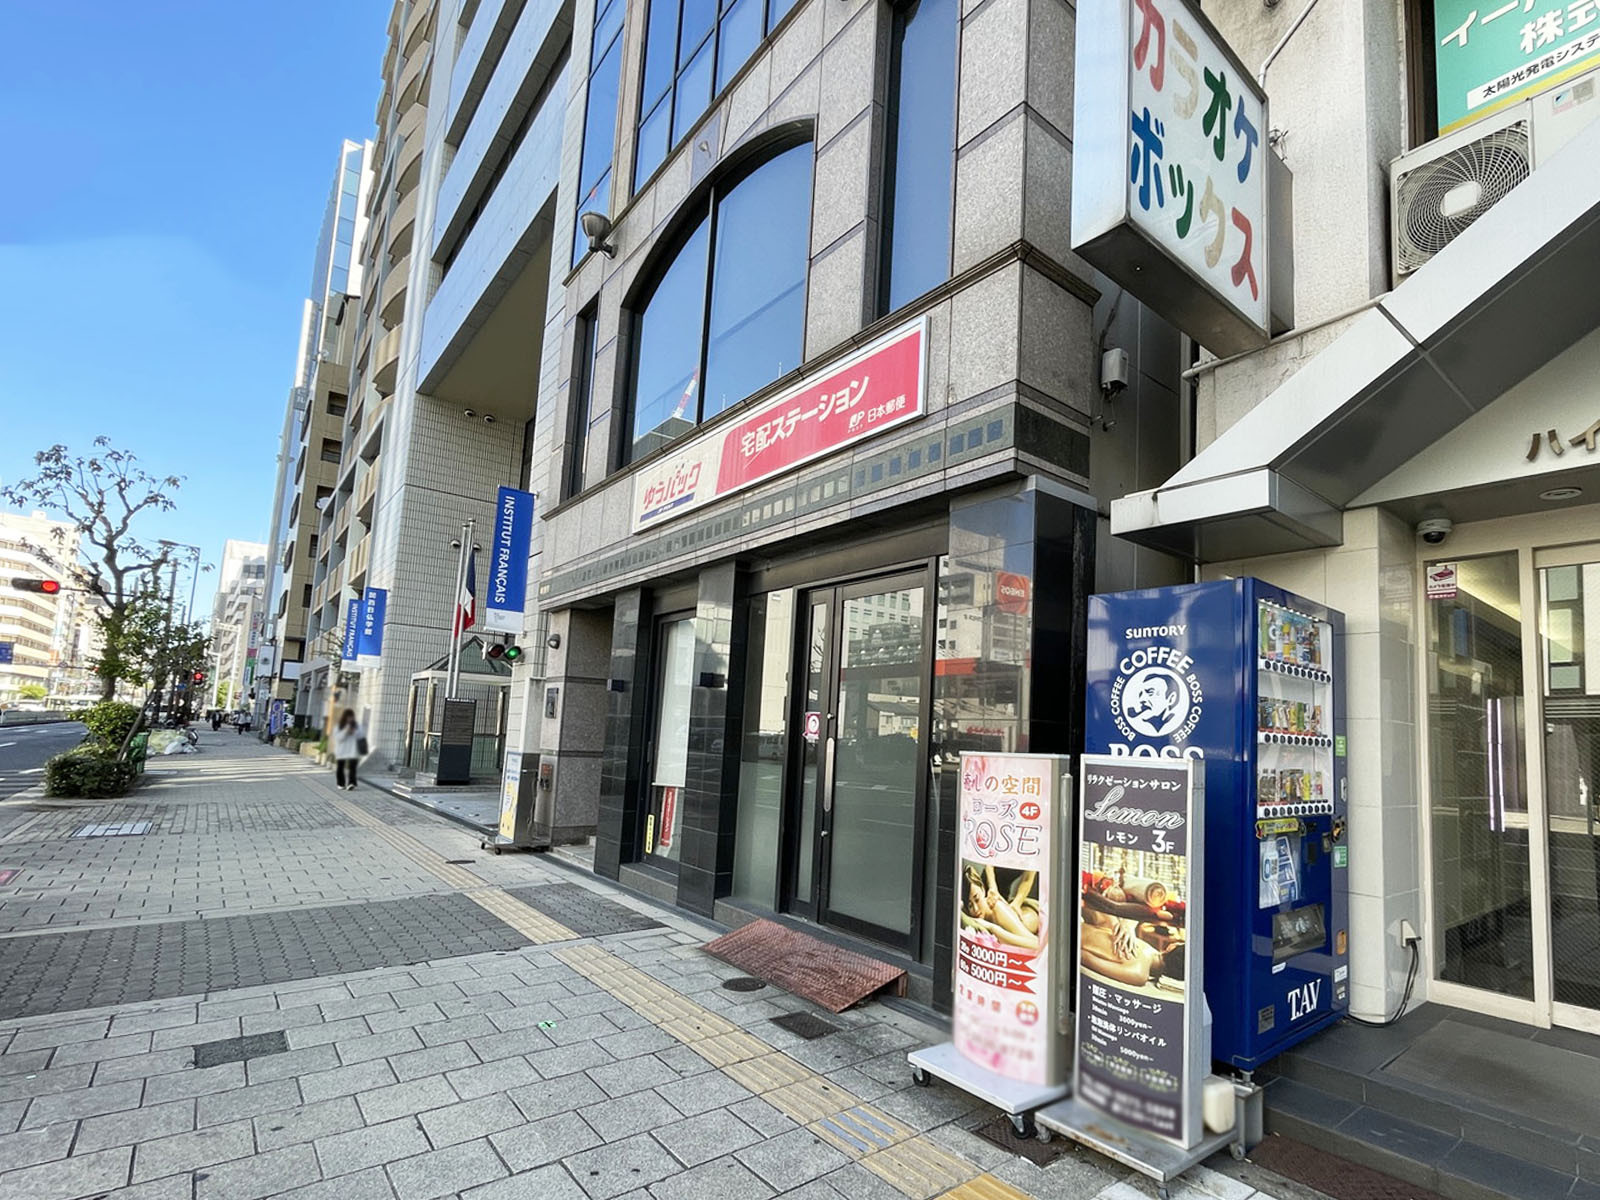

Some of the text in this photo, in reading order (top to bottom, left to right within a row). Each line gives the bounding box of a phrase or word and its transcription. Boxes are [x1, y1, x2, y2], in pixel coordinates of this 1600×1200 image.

[1134, 0, 1259, 184] カラオケ
[1132, 107, 1259, 302] ボックス
[740, 375, 870, 458] 宅配ステーション
[867, 394, 906, 423] 日本郵便
[643, 461, 703, 511] ゆうパック
[499, 495, 516, 547] INSTITUT
[493, 547, 511, 604] FRANÇAIS
[1119, 646, 1194, 675] COFFEE
[1110, 675, 1136, 742] BOSS COFFEE
[1172, 673, 1203, 743] BOSS COFFEE
[1085, 785, 1186, 830] Lemon
[1087, 773, 1182, 792] リラクゼーションサロン
[1021, 805, 1039, 817] 4F
[1105, 830, 1175, 853] レモン 3F
